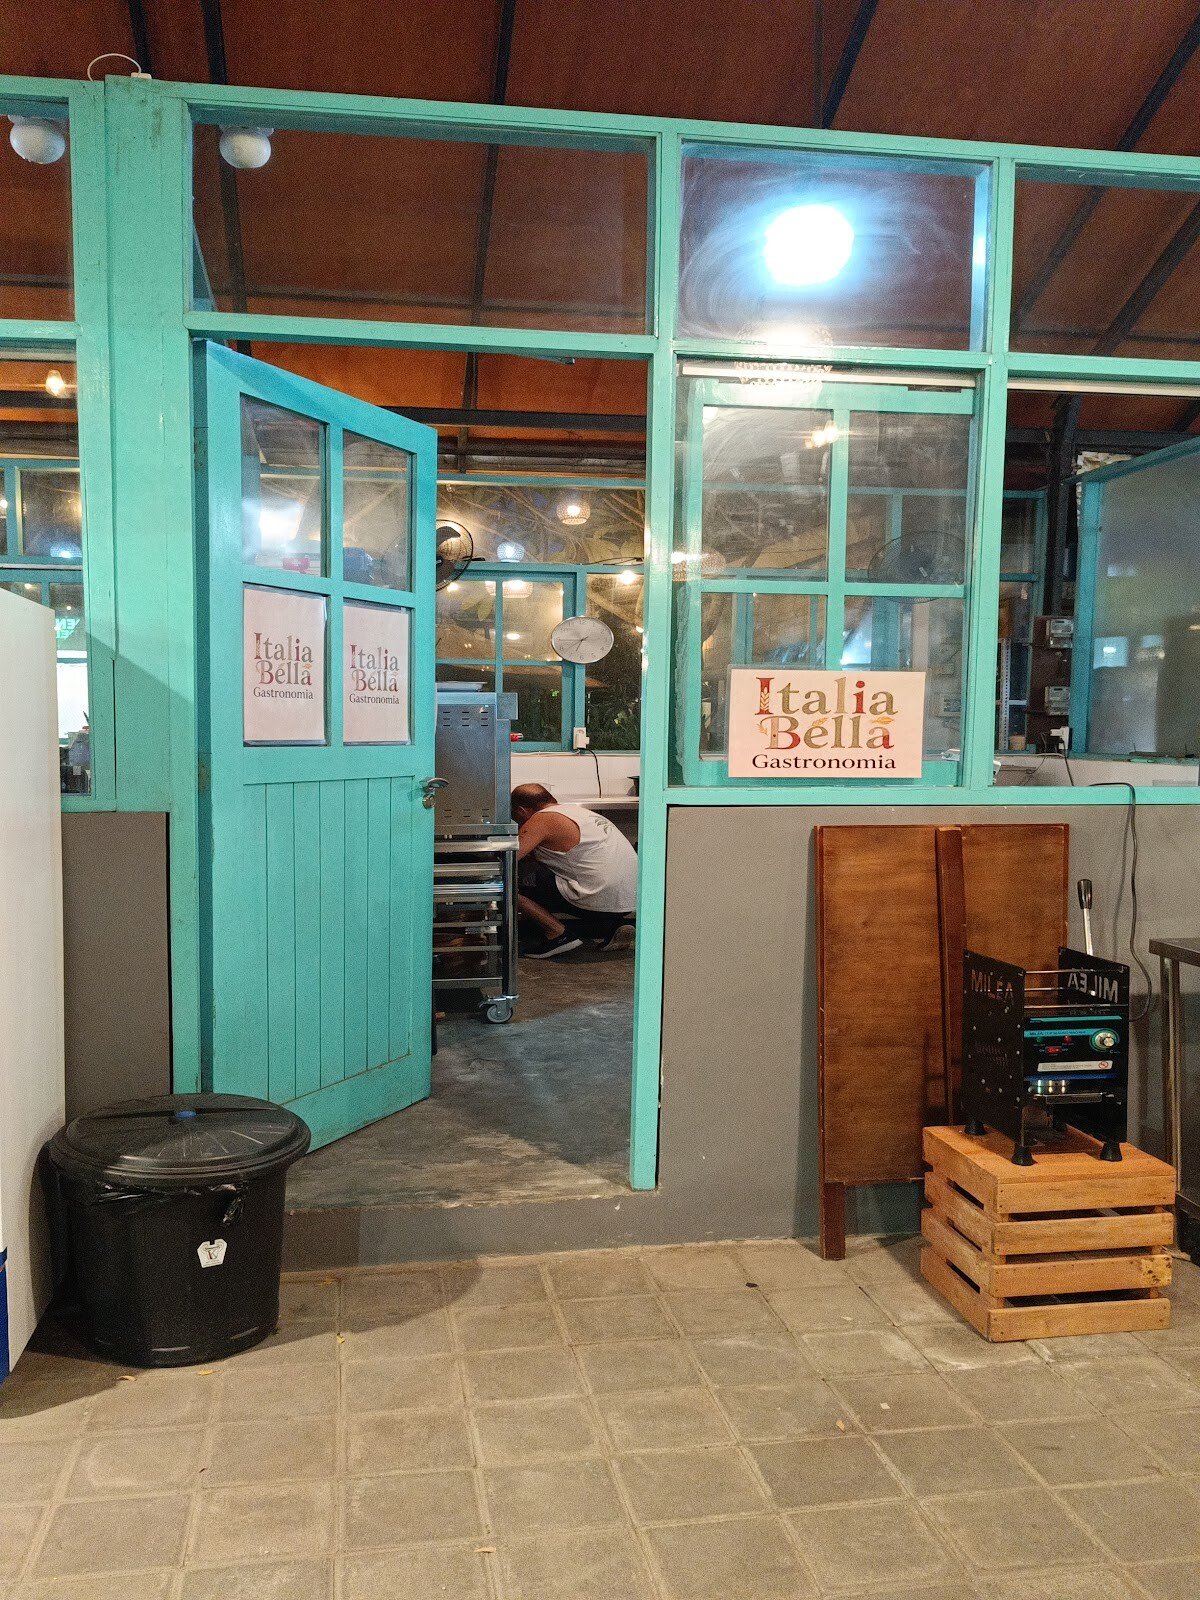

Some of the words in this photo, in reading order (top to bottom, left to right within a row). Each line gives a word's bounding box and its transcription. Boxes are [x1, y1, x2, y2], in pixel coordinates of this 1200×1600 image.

[254, 632, 313, 663] Italia
[350, 644, 399, 671] Italia
[253, 687, 314, 700] Gastronomia
[349, 693, 400, 705] Gastronomia
[755, 677, 898, 716] Italia
[752, 754, 896, 769] Gastronomia
